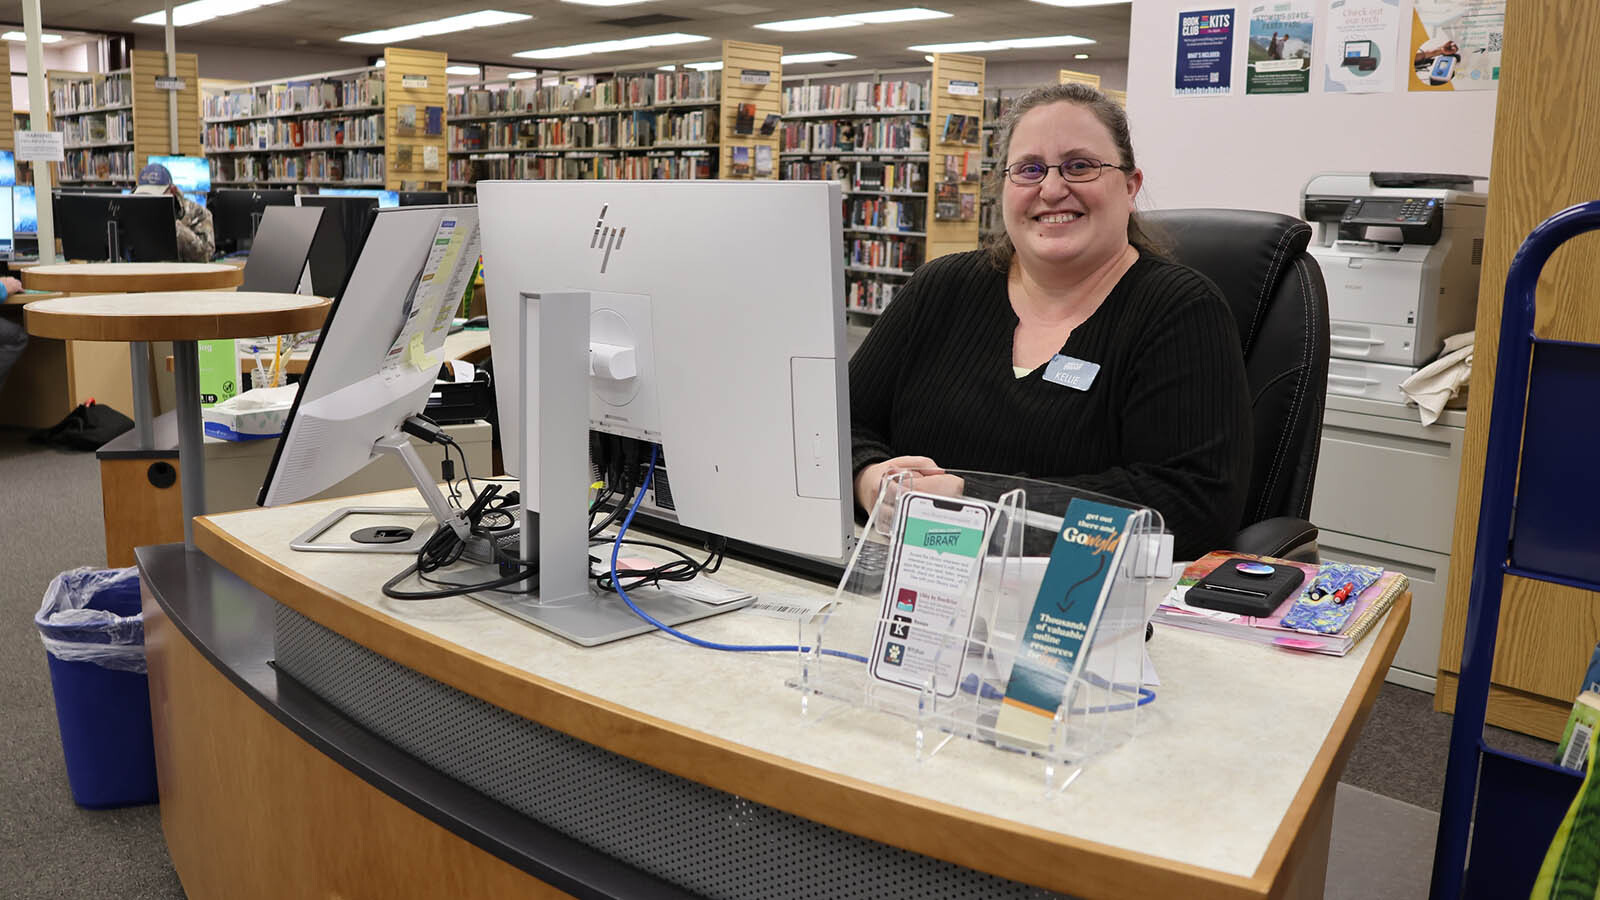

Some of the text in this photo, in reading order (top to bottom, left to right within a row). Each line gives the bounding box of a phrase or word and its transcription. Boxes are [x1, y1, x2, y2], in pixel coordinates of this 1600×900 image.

[1183, 14, 1230, 28] BOOK KITS
[1182, 25, 1200, 36] CLUB
[590, 203, 626, 274] hp
[1085, 513, 1099, 521] get
[1077, 520, 1099, 530] there
[923, 532, 960, 546] LIBRARY
[1040, 613, 1087, 631] Thousands
[1035, 623, 1083, 640] of valuable
[1032, 633, 1061, 645] online
[1030, 641, 1074, 657] resources
